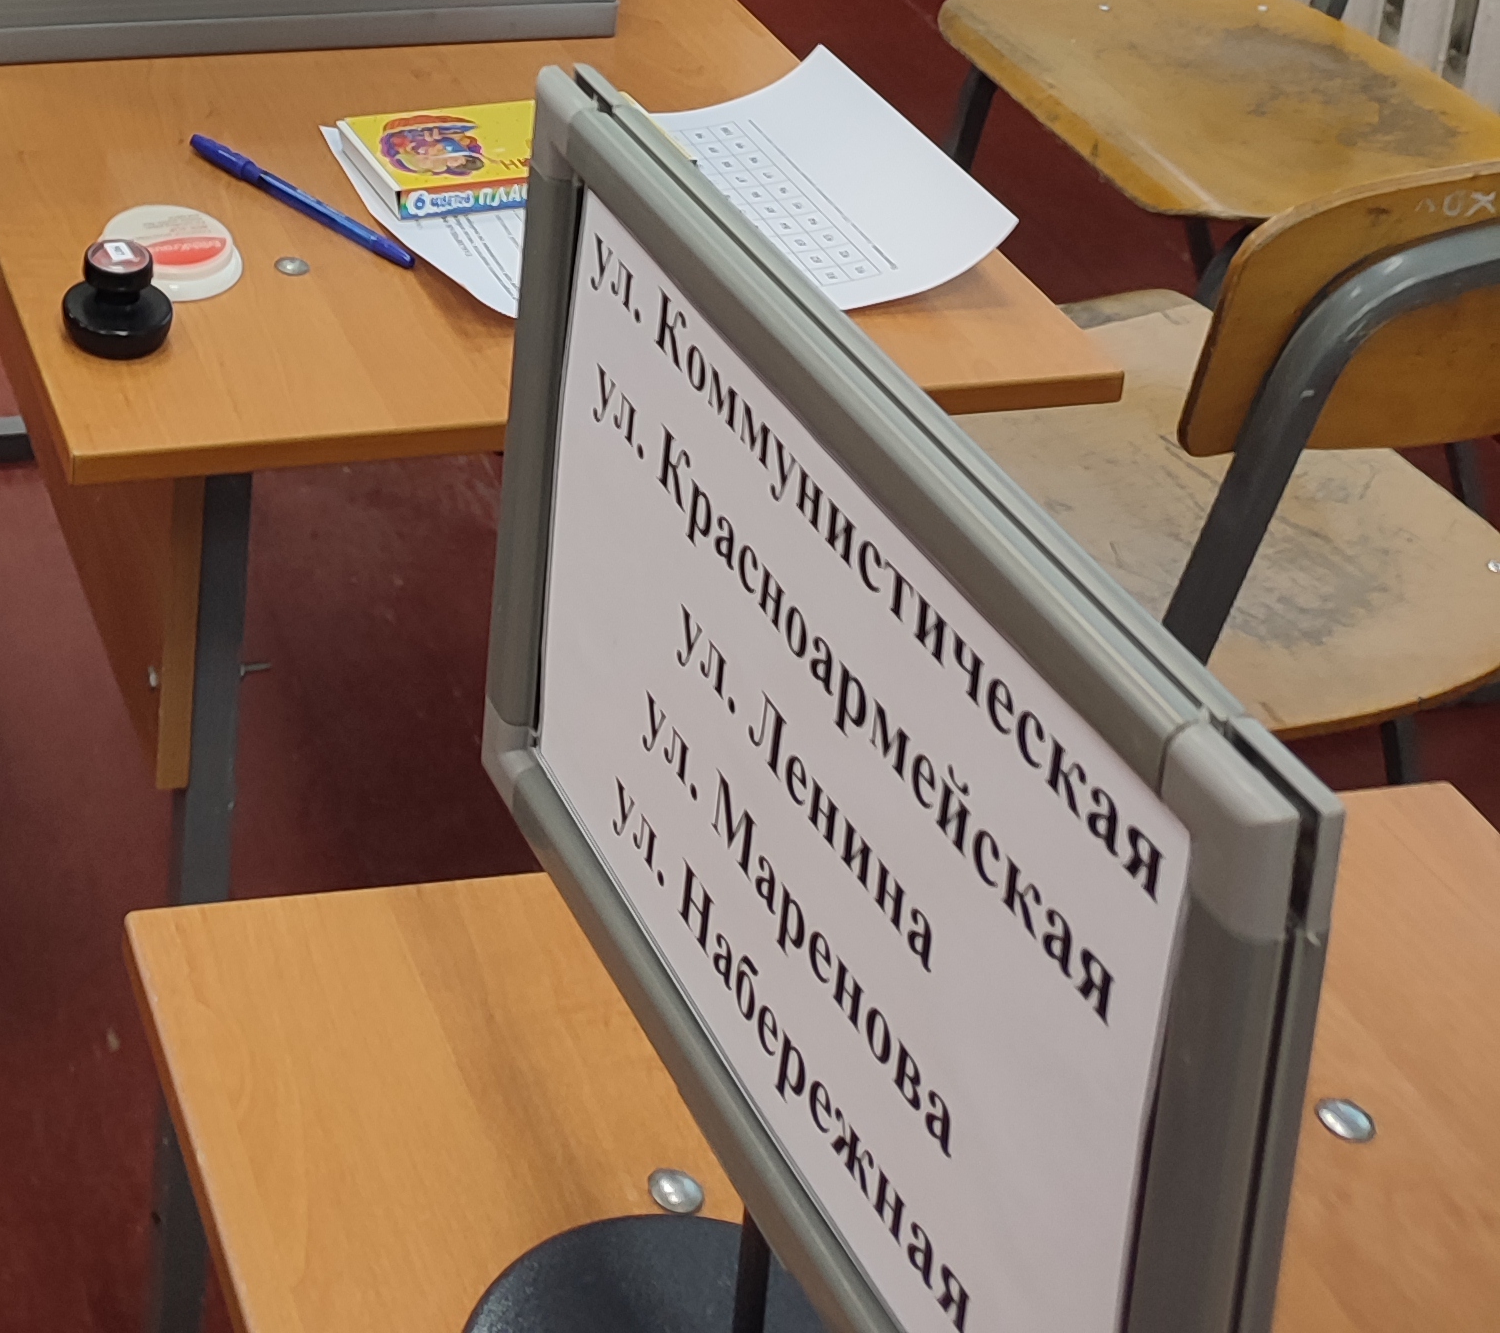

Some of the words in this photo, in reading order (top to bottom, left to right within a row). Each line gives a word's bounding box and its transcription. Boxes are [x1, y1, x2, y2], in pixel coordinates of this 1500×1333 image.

[590, 232, 642, 324] ул.
[654, 285, 1165, 904] Коммунистическая
[592, 363, 644, 460] ул.
[656, 422, 1115, 1026] Красноармейская
[676, 602, 736, 715] ул.
[748, 689, 932, 973] Ленина
[612, 775, 665, 888] ул.
[677, 857, 970, 1333] Набережная
[642, 689, 698, 801] ул.
[711, 767, 952, 1159] Маренова
